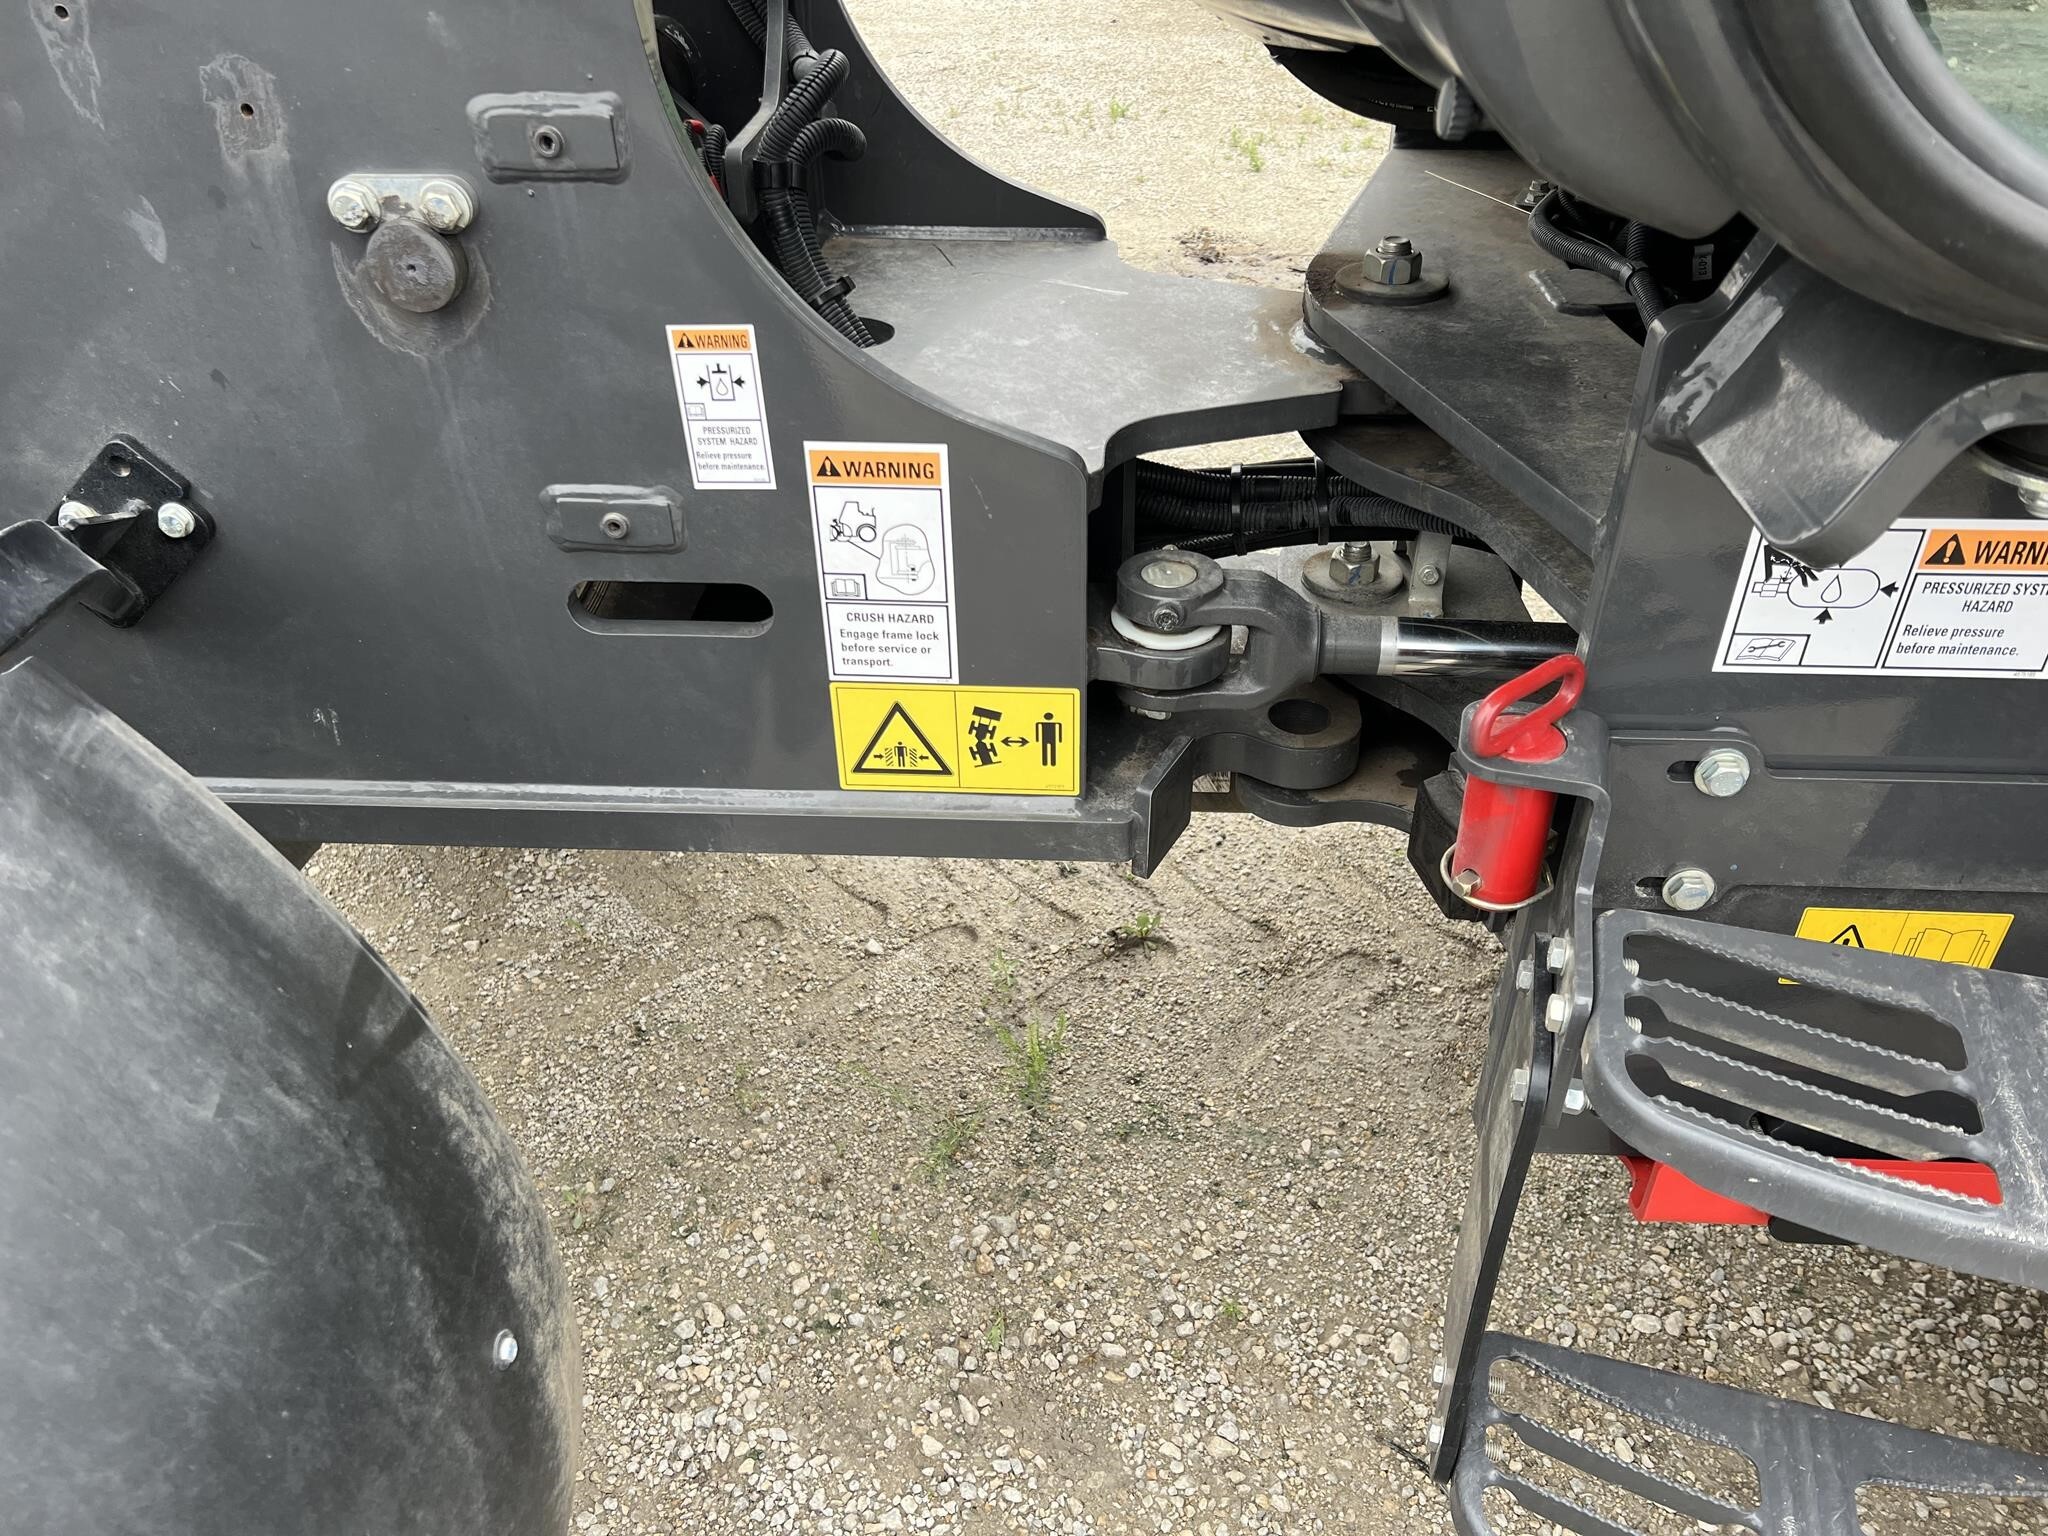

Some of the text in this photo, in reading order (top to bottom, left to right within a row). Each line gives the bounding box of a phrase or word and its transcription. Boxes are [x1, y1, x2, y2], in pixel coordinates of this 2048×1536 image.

[694, 334, 749, 349] WARNING
[702, 426, 751, 435] PRESSURIZED
[697, 437, 758, 446] SYSTEM HAZARD
[696, 451, 752, 462] Relieve pressure
[698, 462, 720, 471] before
[842, 460, 935, 480] WARNING
[1974, 540, 2048, 564] WARNI
[1921, 582, 2048, 596] PRESSURIZED SYST
[1961, 600, 2014, 613] HAZARD
[846, 612, 935, 624] CRUSH HAZARD
[840, 628, 939, 641] Engage frame lock
[1902, 624, 2005, 640] Relieve pressure
[841, 643, 932, 654] before service or
[1896, 642, 2019, 656] before maintenance.
[842, 657, 893, 667] transport.
